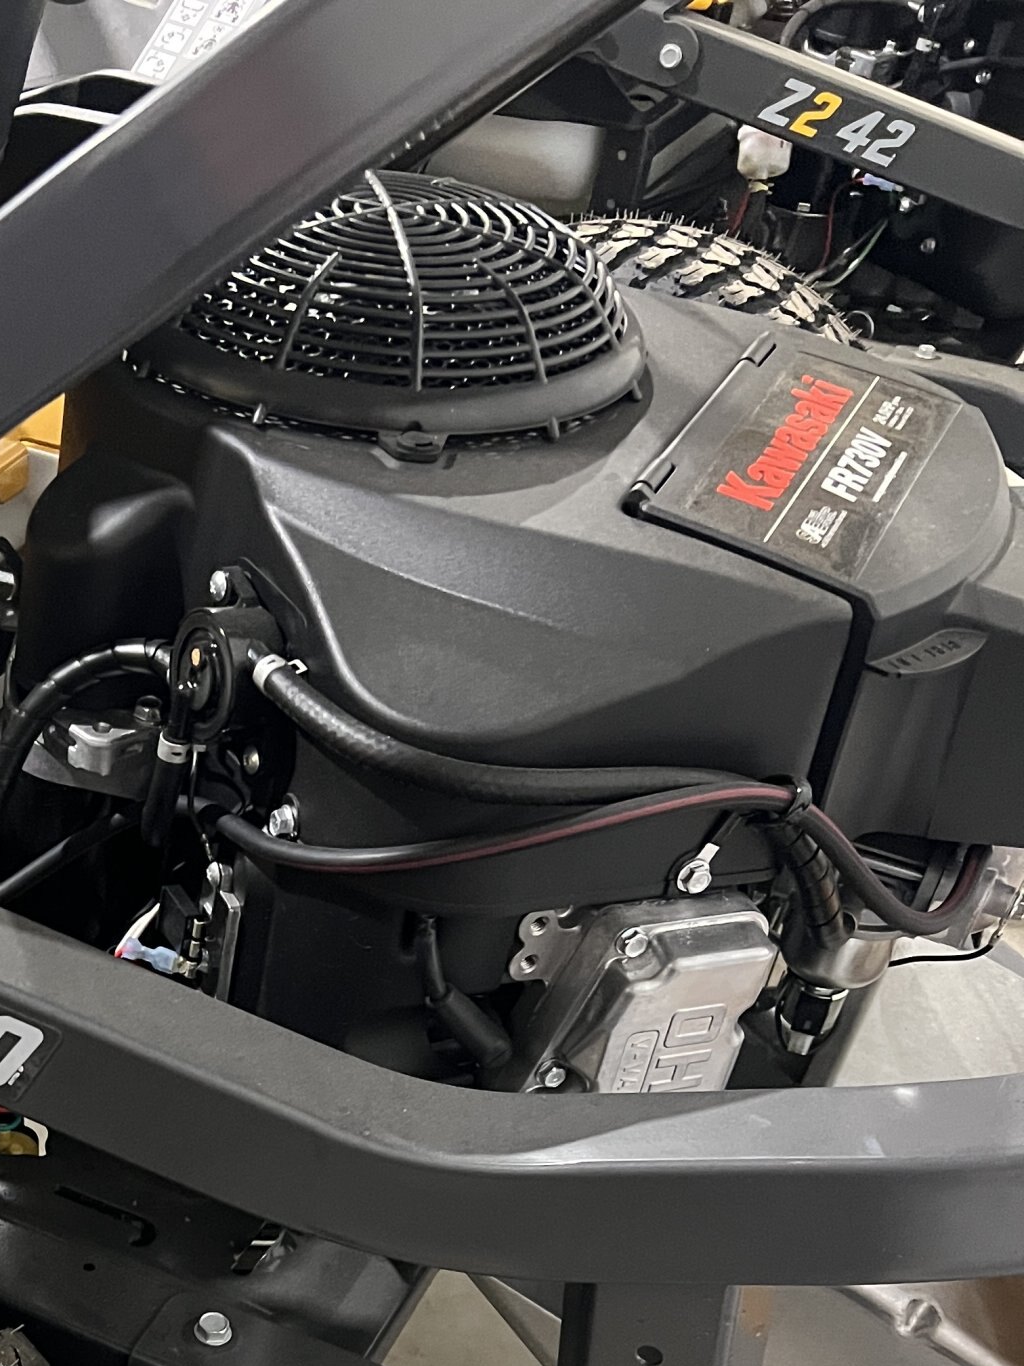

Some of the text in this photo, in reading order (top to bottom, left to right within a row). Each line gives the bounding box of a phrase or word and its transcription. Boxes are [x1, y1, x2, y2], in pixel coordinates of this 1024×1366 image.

[757, 77, 916, 168] Z2 42
[716, 374, 854, 512] Kawasaki
[821, 427, 893, 503] FR730V
[647, 1003, 727, 1092] OH
